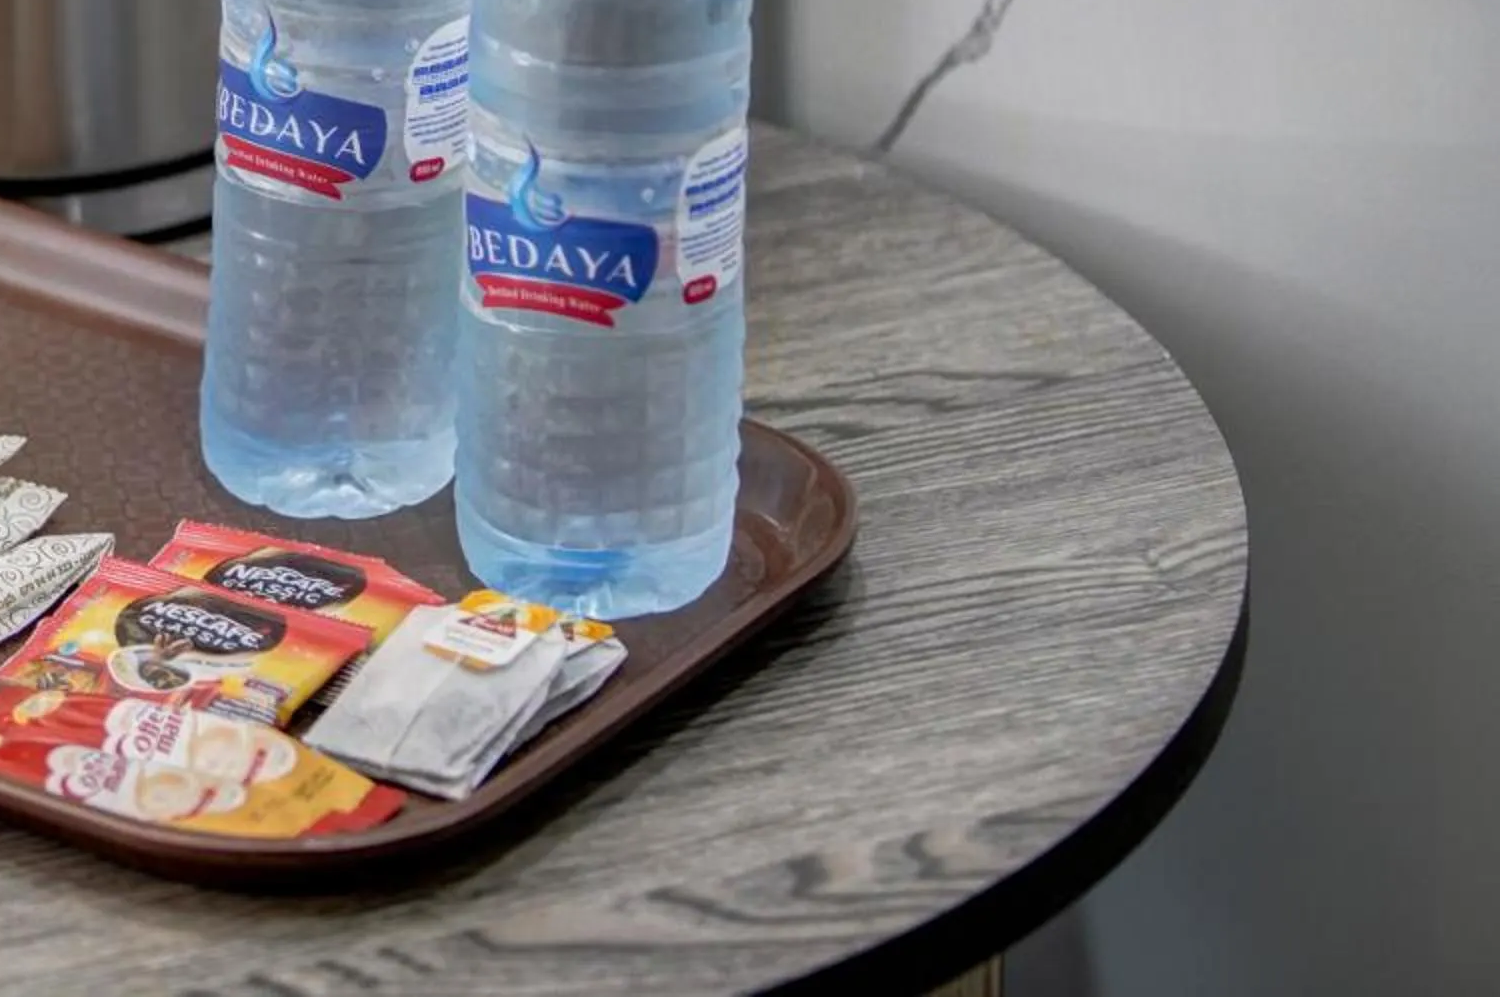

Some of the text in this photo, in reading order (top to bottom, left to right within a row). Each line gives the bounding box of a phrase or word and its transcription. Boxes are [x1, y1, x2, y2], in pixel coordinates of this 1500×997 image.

[219, 86, 366, 166] BEDAYA
[469, 224, 638, 289] BEDAYA
[222, 579, 321, 605] CLASSIC
[140, 614, 240, 651] CLASSIC
